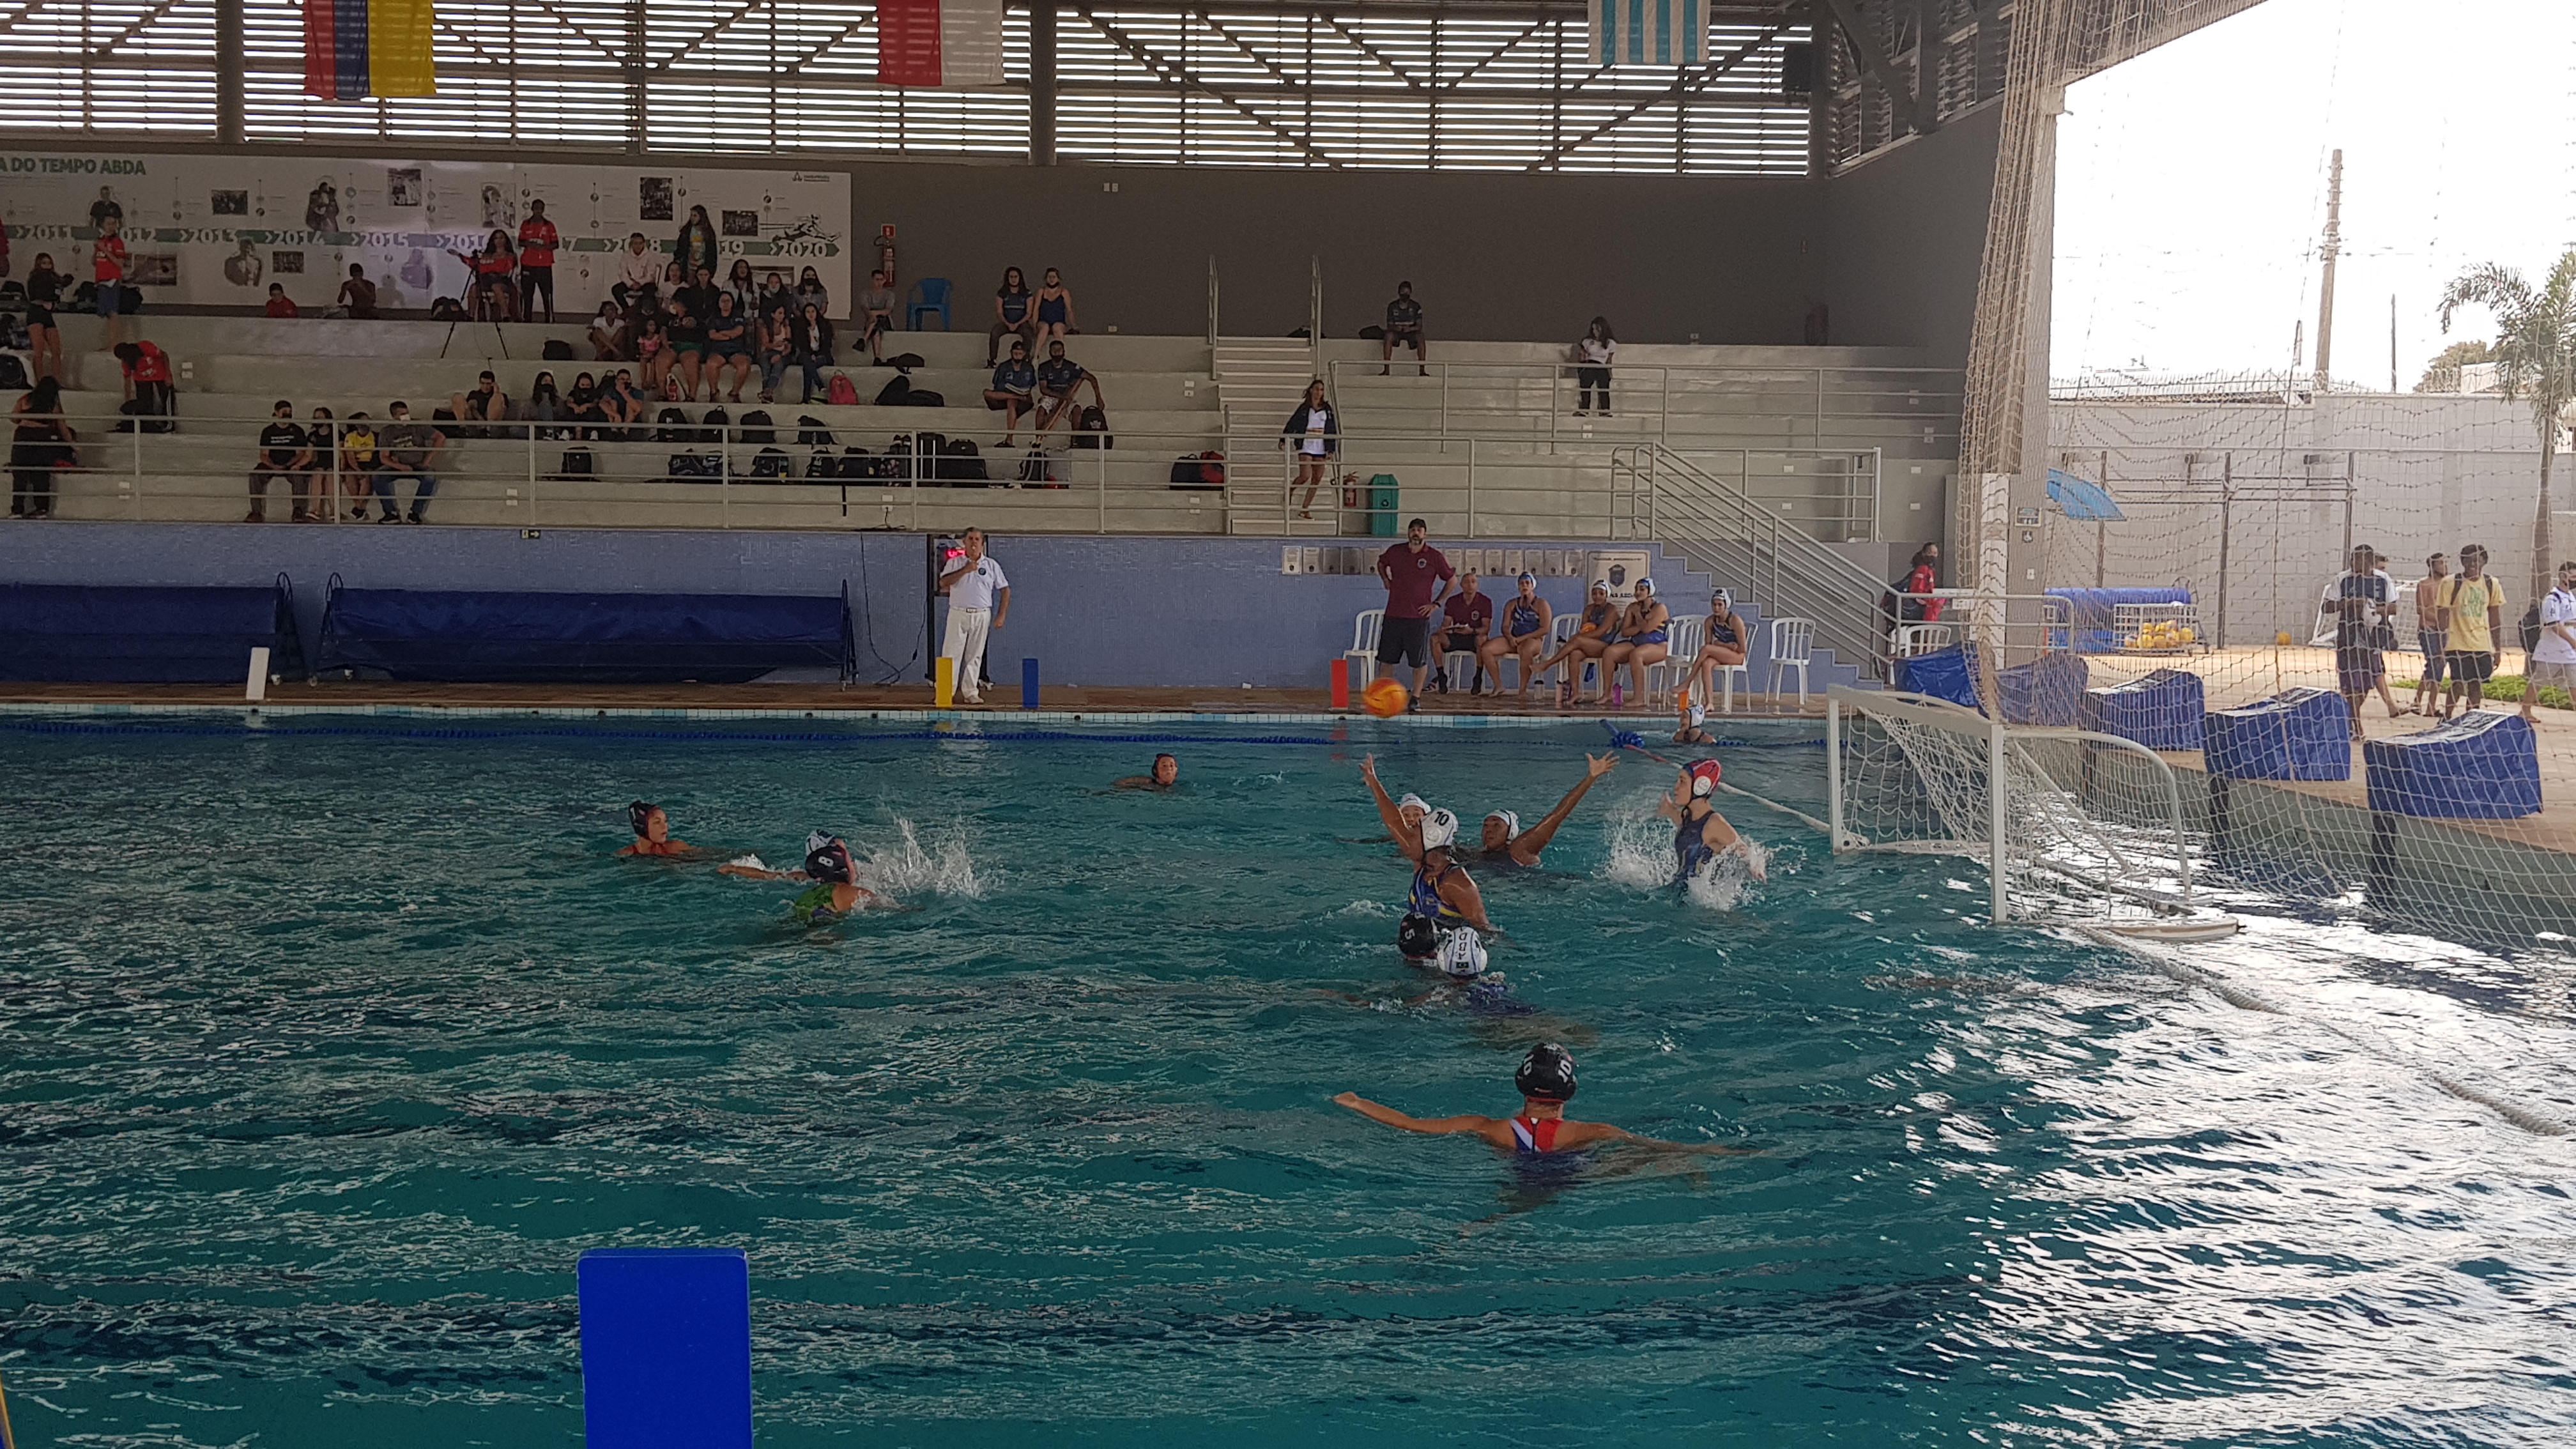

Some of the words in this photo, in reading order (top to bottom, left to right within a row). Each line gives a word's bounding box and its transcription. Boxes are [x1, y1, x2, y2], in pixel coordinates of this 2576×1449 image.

[11, 157, 36, 172] DO
[38, 158, 96, 174] TEMPO
[100, 159, 146, 175] ABDA
[27, 225, 72, 240] 2011
[116, 227, 157, 241] 012
[189, 228, 237, 243] 2013
[275, 230, 325, 246] 2014
[362, 231, 410, 247] 2015
[612, 238, 662, 253] 208
[779, 241, 827, 257] 2020
[1434, 811, 1450, 826] 10
[818, 855, 834, 868] 8
[1404, 928, 1415, 940] 5
[1557, 1059, 1572, 1083] 10
